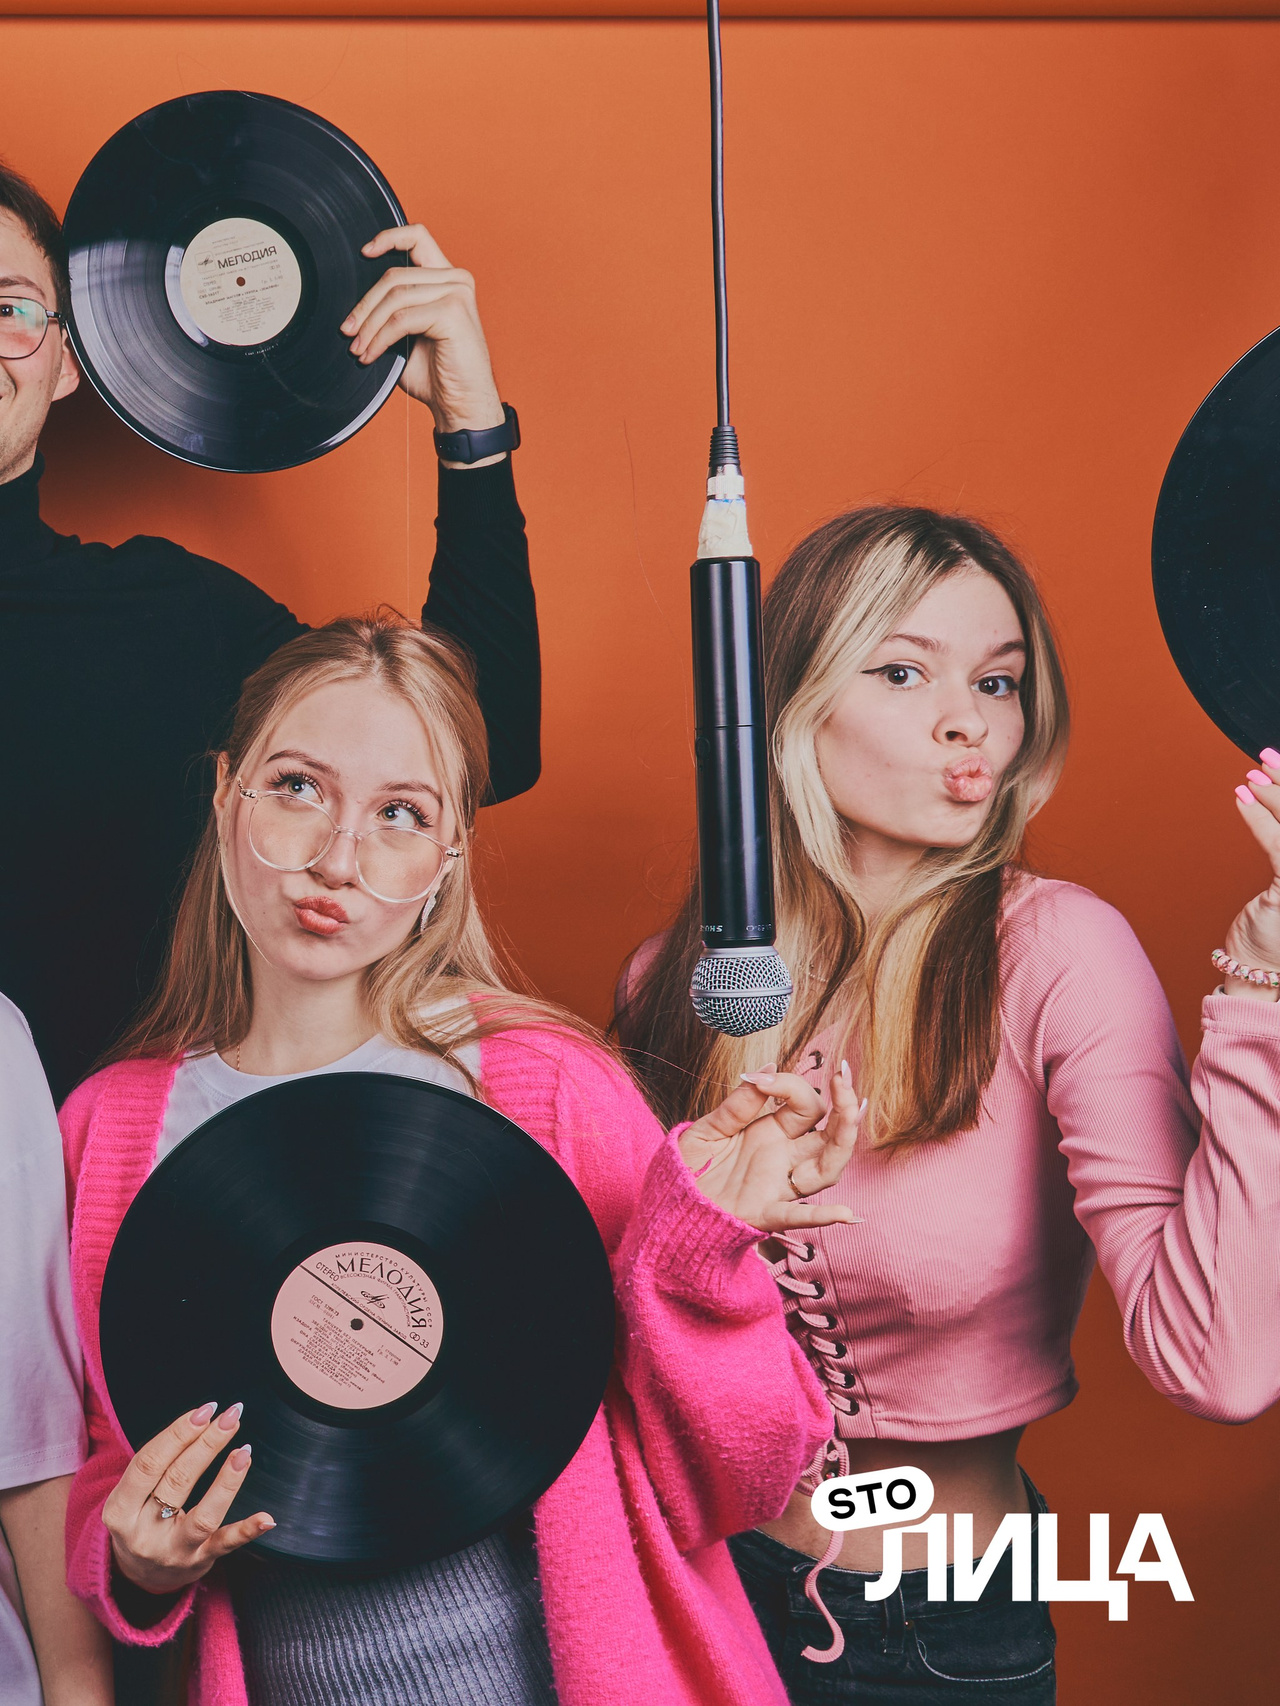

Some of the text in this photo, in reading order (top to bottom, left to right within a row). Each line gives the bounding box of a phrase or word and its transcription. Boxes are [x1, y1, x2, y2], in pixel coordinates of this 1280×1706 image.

[216, 245, 277, 269] МЕЛОДИЯ
[314, 1261, 340, 1282] СТЕРЕО
[335, 1252, 398, 1267] МИНИСТЕРСТВО
[400, 1267, 428, 1303] КУЛЬТУРЫ
[336, 1258, 427, 1328] МЕЛОДИЯ
[359, 1302, 376, 1317] ОРДЕНА
[375, 1314, 393, 1329] ЛЕНИНА
[392, 1327, 407, 1339] ЗАВОД
[418, 1337, 430, 1349] 33
